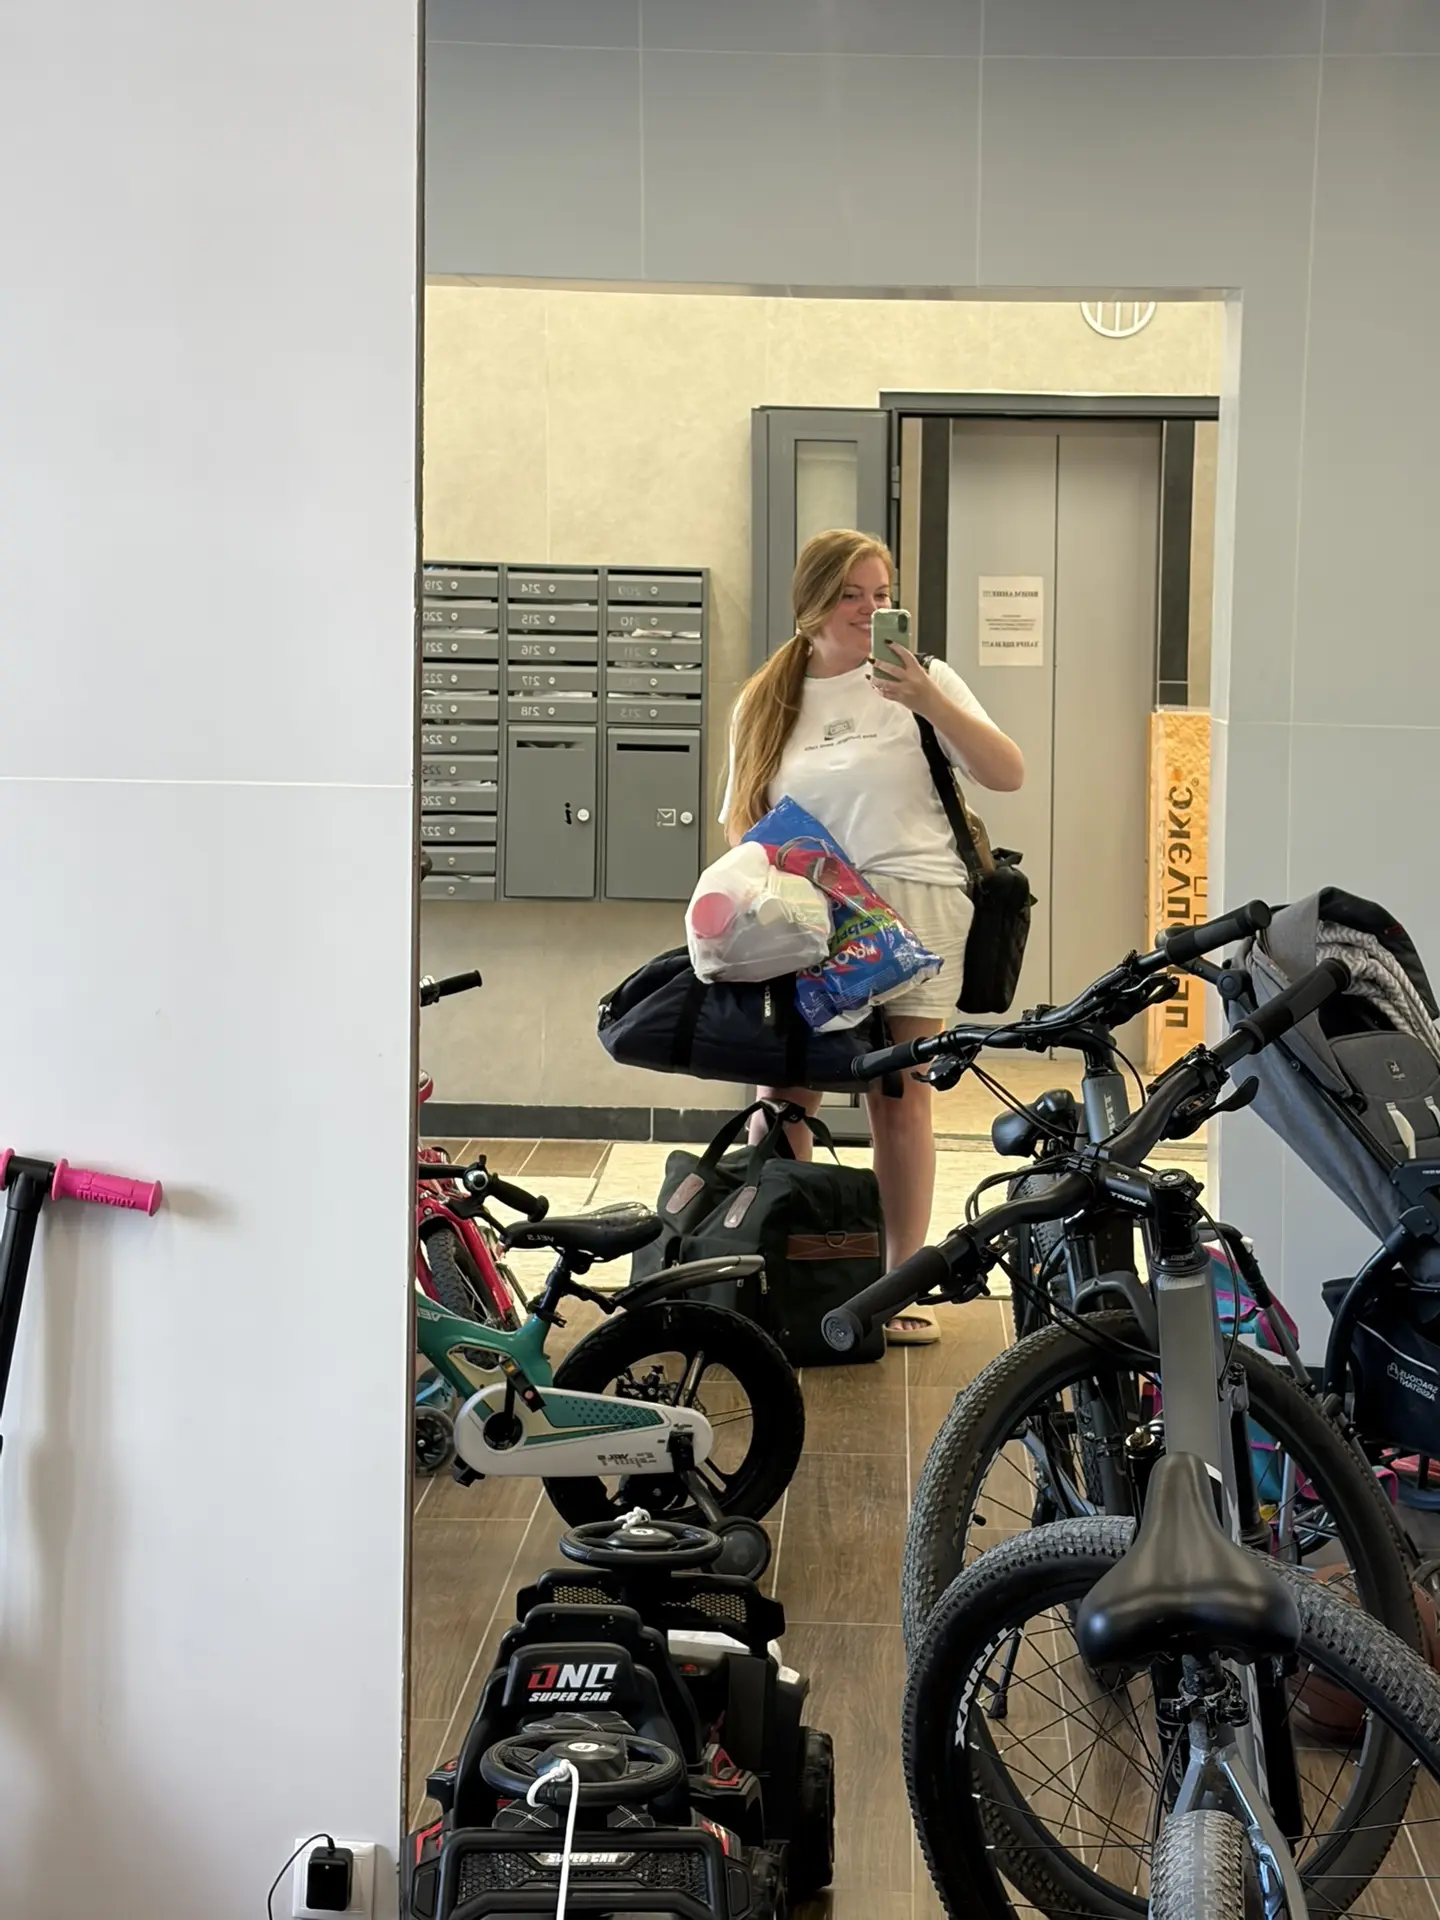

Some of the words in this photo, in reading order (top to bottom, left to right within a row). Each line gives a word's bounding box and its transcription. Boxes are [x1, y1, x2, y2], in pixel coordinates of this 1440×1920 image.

[955, 1627, 1016, 1749] TRINX
[529, 1692, 578, 1702] SUPER
[579, 1692, 612, 1701] CAR
[548, 1853, 589, 1862] SUER
[590, 1853, 618, 1862] CAR
